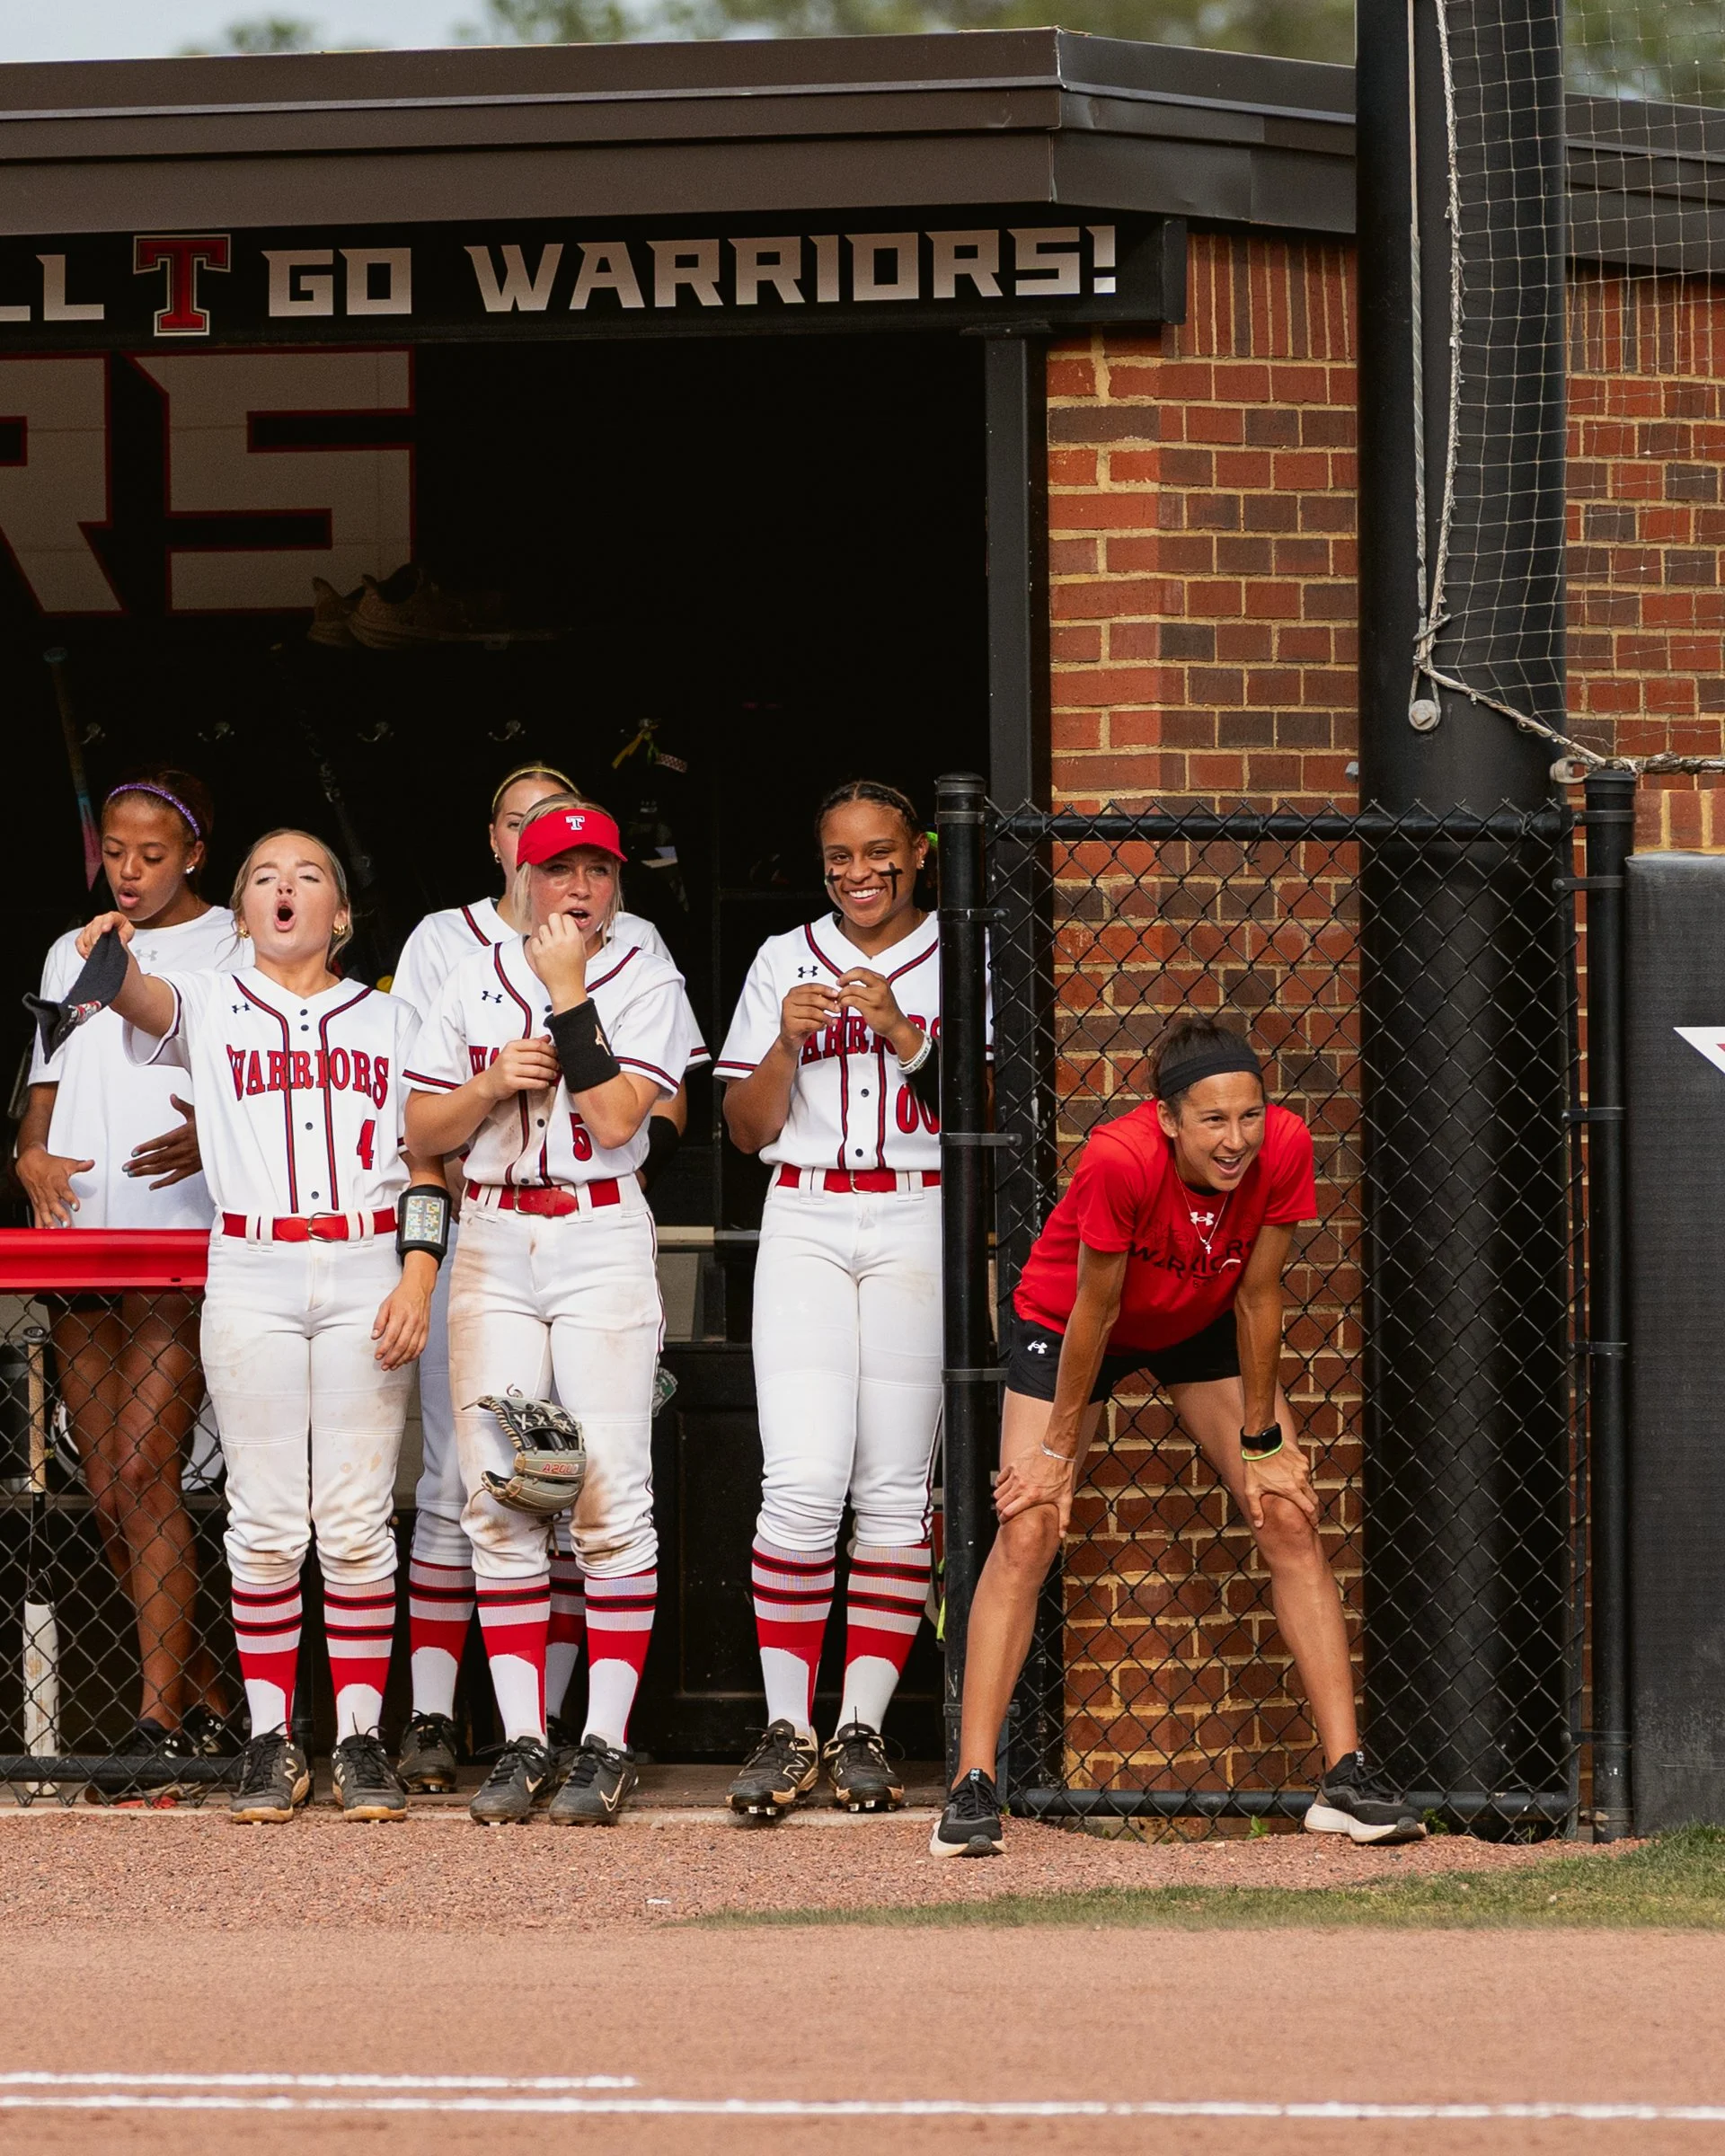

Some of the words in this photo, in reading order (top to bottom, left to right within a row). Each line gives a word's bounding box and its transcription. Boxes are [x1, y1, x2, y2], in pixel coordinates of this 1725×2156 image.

[133, 233, 232, 337] T
[261, 247, 412, 317] GO
[463, 225, 1117, 313] WARRIORS!
[565, 815, 586, 831] T
[356, 1118, 376, 1171] 4
[569, 1111, 594, 1162] 5
